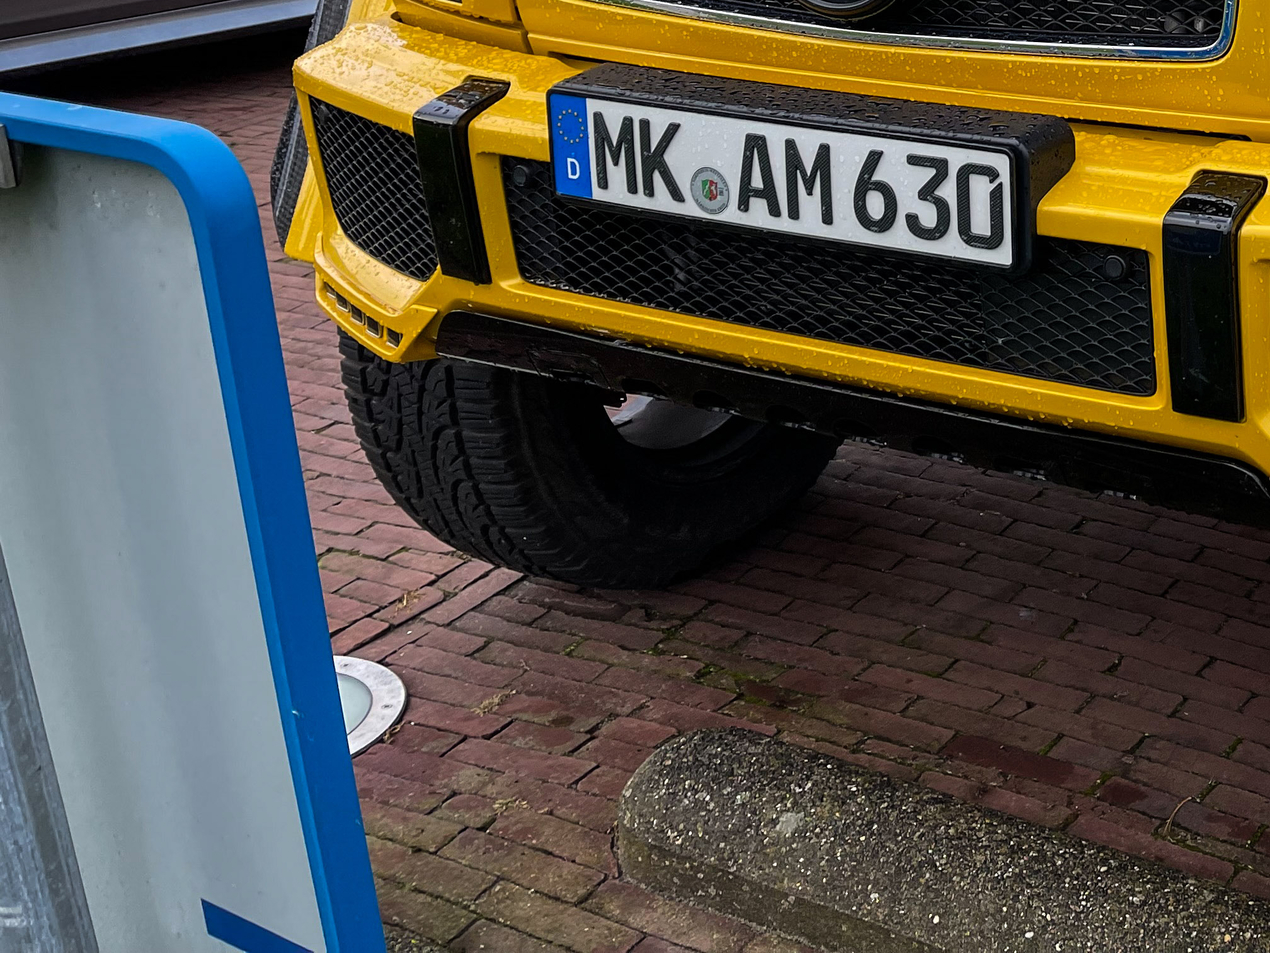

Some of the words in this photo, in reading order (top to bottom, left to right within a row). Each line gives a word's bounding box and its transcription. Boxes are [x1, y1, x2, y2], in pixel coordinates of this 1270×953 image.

[566, 157, 581, 180] D
[593, 111, 685, 203] MK
[737, 133, 833, 226] AM
[853, 149, 1005, 250] 630
